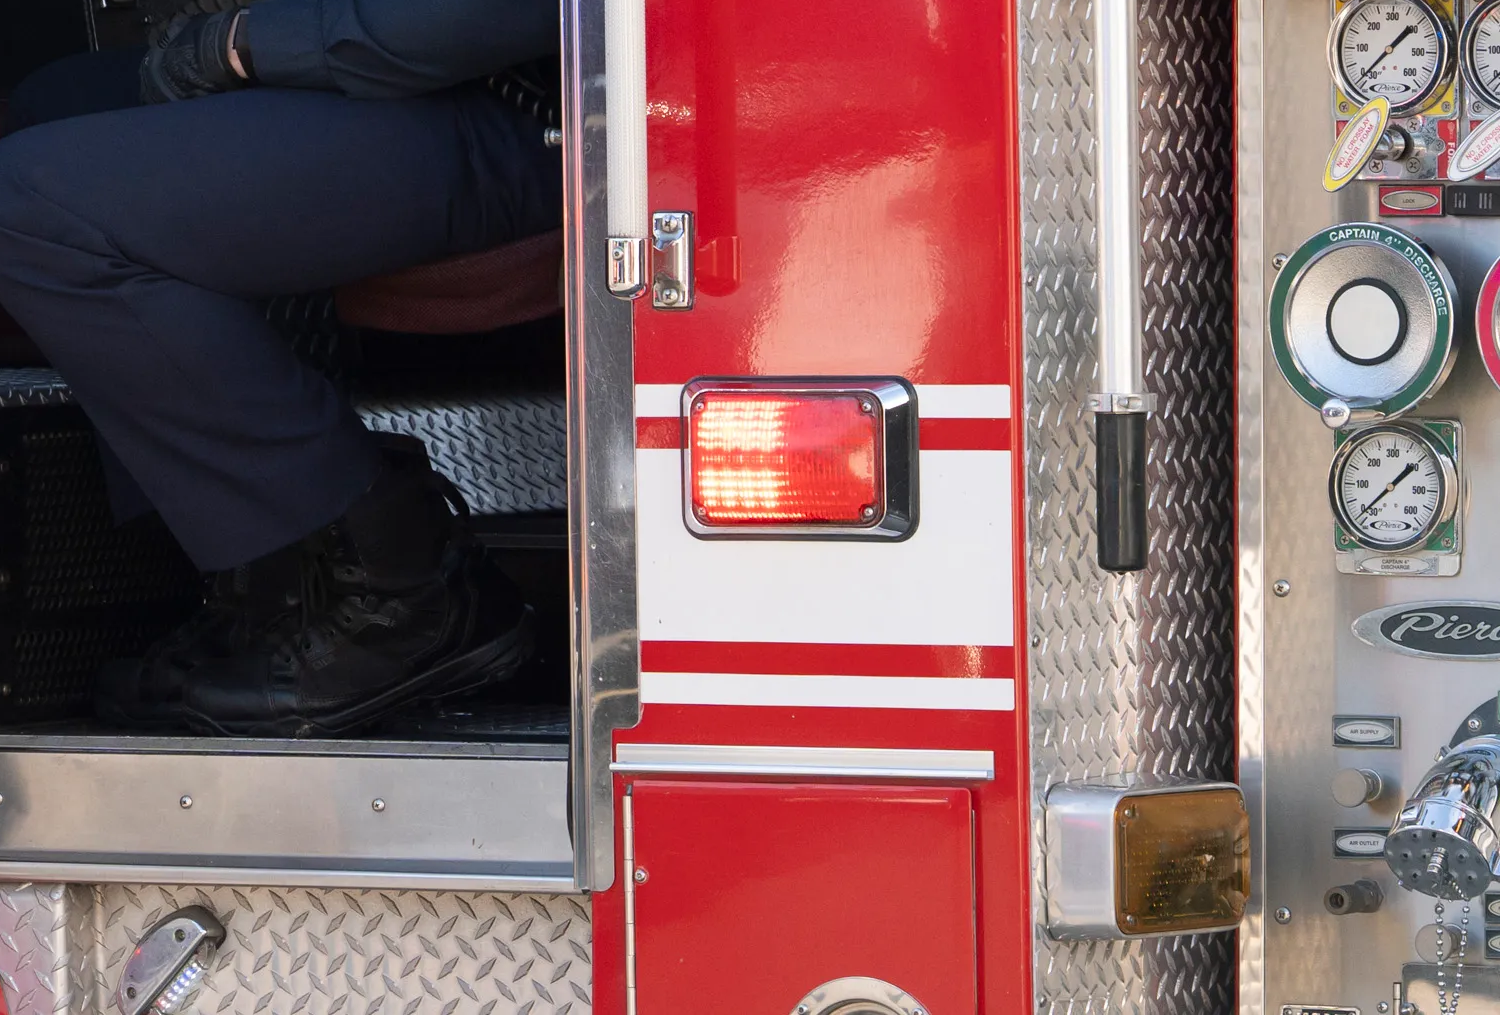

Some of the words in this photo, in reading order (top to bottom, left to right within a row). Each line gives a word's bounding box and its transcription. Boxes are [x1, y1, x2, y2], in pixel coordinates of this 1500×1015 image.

[1386, 12, 1400, 21] 300
[1368, 22, 1380, 30] 200
[1356, 44, 1368, 52] 100
[1412, 48, 1425, 56] 500
[1404, 68, 1417, 76] 600
[1348, 117, 1371, 152] CROSSLAY
[1344, 147, 1360, 168] WATER
[1360, 124, 1374, 144] FOAM
[1472, 144, 1493, 162] WATER
[1330, 228, 1380, 242] CAPTAIN
[1403, 246, 1448, 316] DISCHARGE
[1386, 448, 1400, 458] 300
[1368, 458, 1381, 468] 200
[1356, 480, 1369, 488] 100
[1412, 486, 1426, 494] 500
[1404, 506, 1418, 514] 600
[1378, 520, 1402, 528] Pierce
